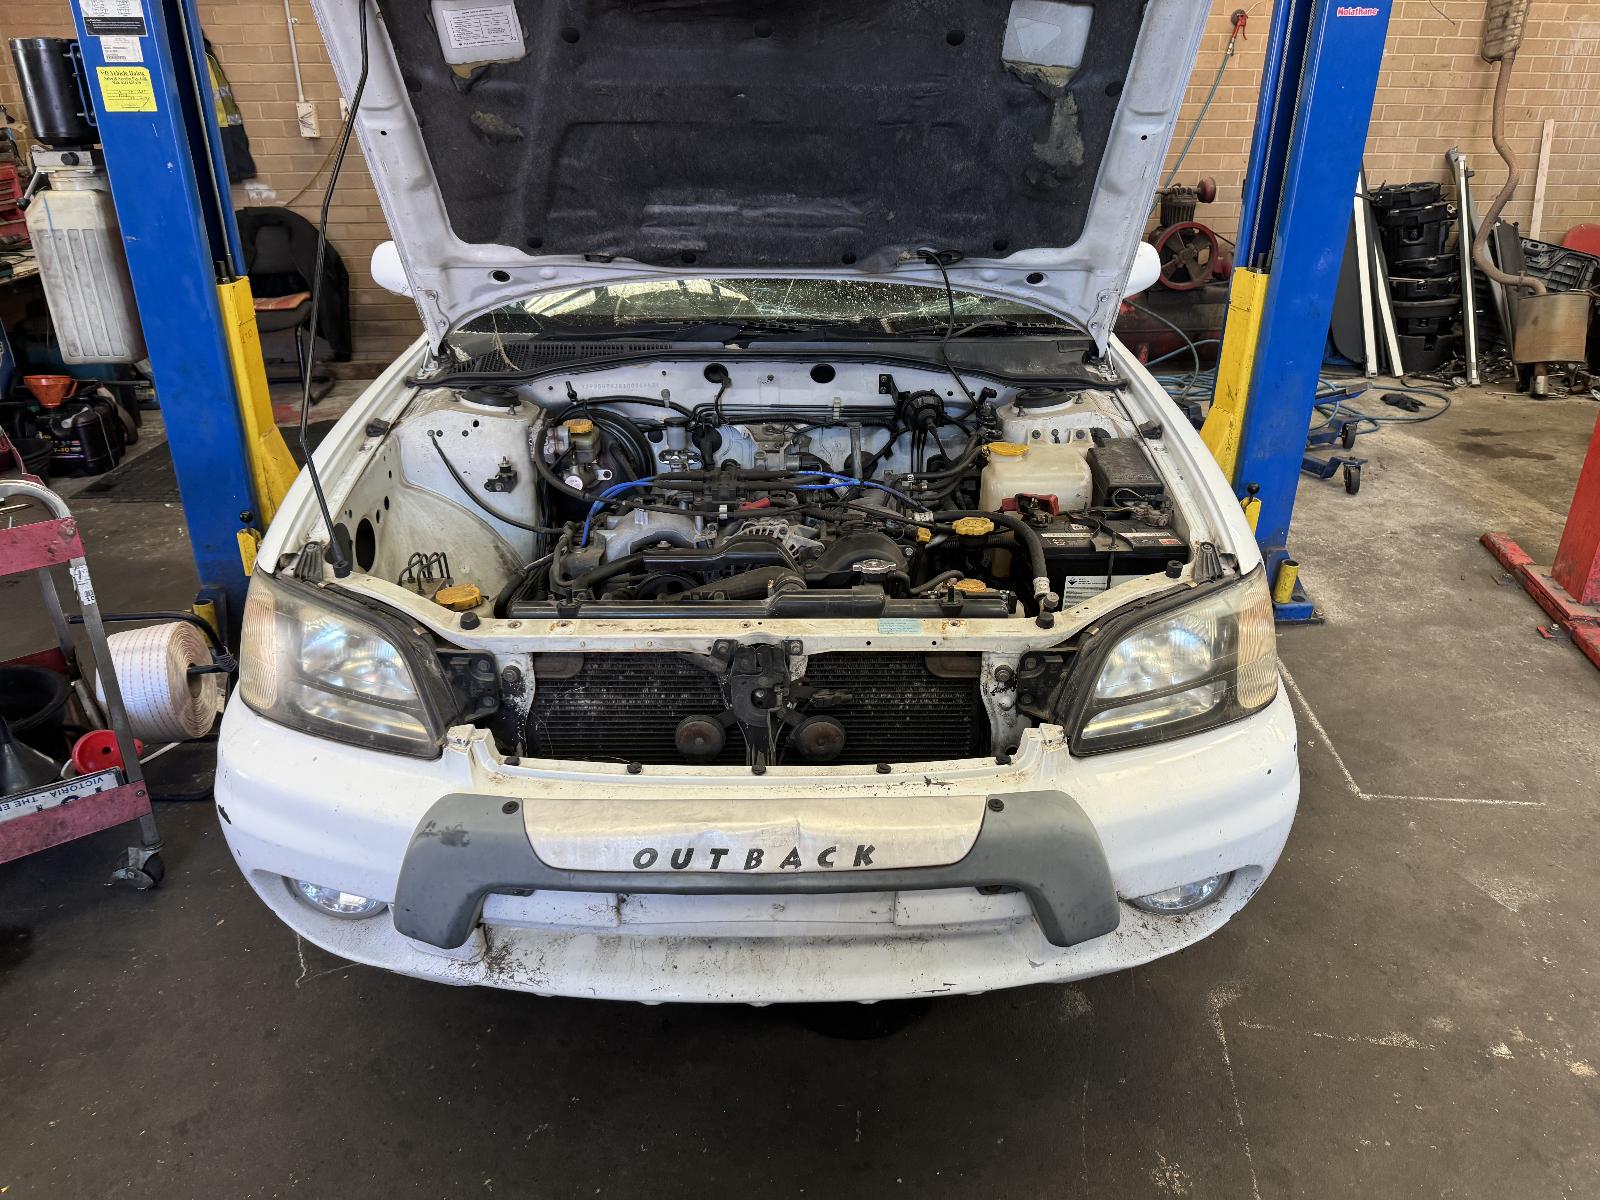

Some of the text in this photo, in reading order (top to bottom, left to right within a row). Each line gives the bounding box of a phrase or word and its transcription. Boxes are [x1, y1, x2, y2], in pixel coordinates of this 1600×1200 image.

[49, 776, 104, 798] VICTORIA
[14, 797, 39, 808] THE
[632, 844, 876, 870] OUTBACK
